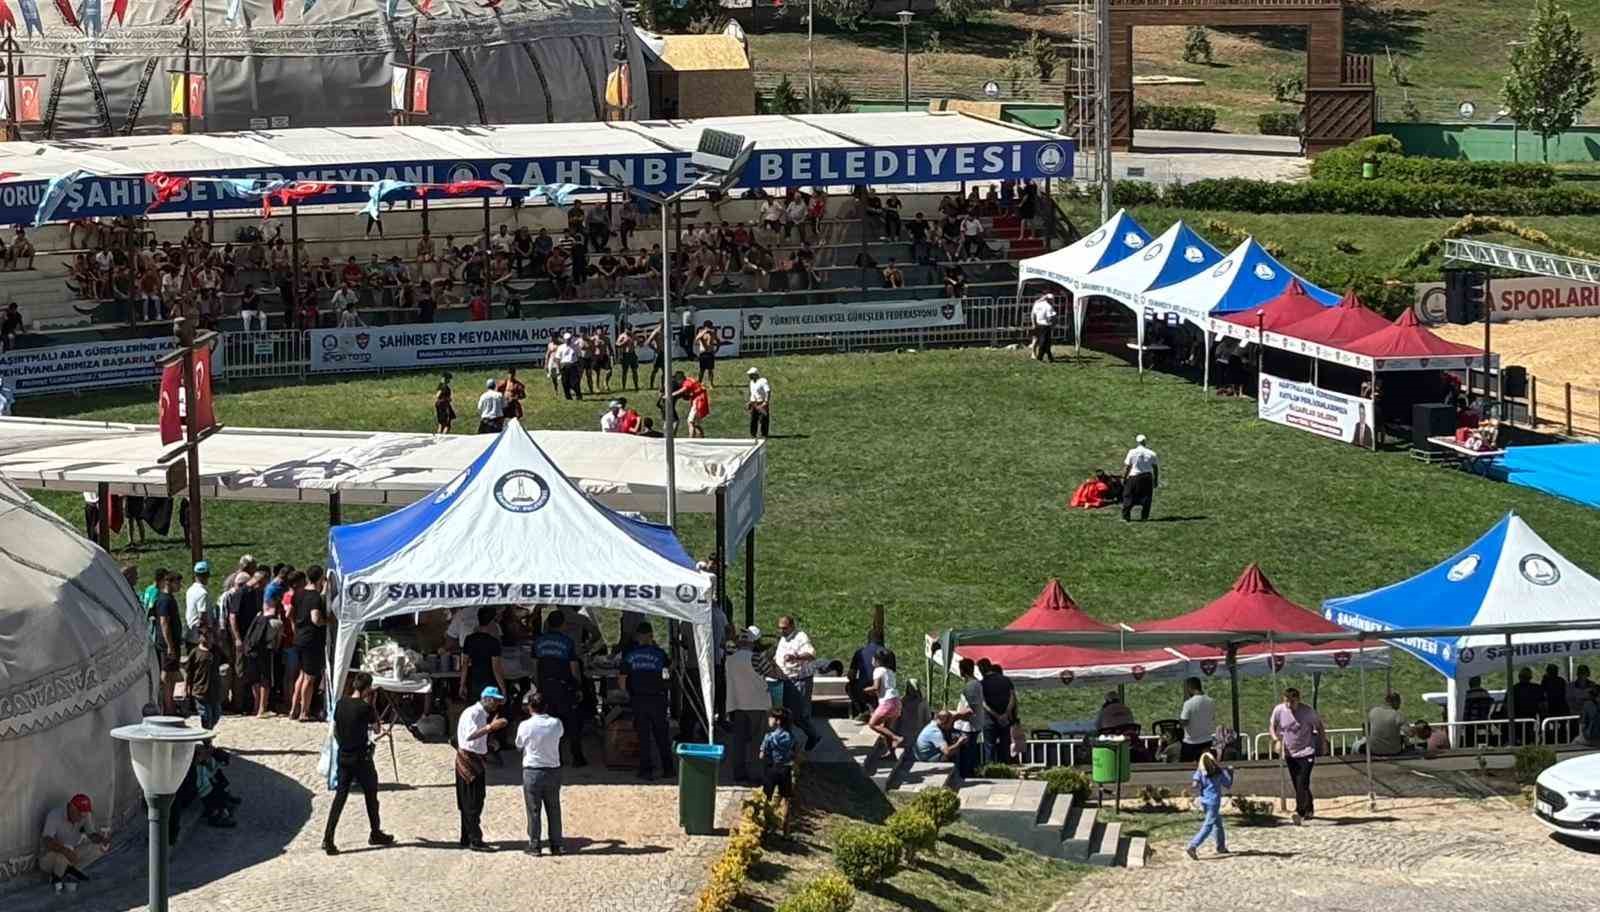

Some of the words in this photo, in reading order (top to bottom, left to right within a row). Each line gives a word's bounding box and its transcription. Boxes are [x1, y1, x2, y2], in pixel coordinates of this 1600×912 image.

[490, 157, 700, 195] ŞAHİNBE
[760, 145, 1021, 180] BELEDİYESİ
[1501, 286, 1600, 312] SPORLARI
[379, 331, 437, 349] ŞAHİNBEY
[441, 332, 456, 345] ER
[458, 328, 528, 344] MEYDANINA
[387, 581, 512, 600] ŞAHİNBEY
[521, 582, 661, 599] BELEDİYESİ
